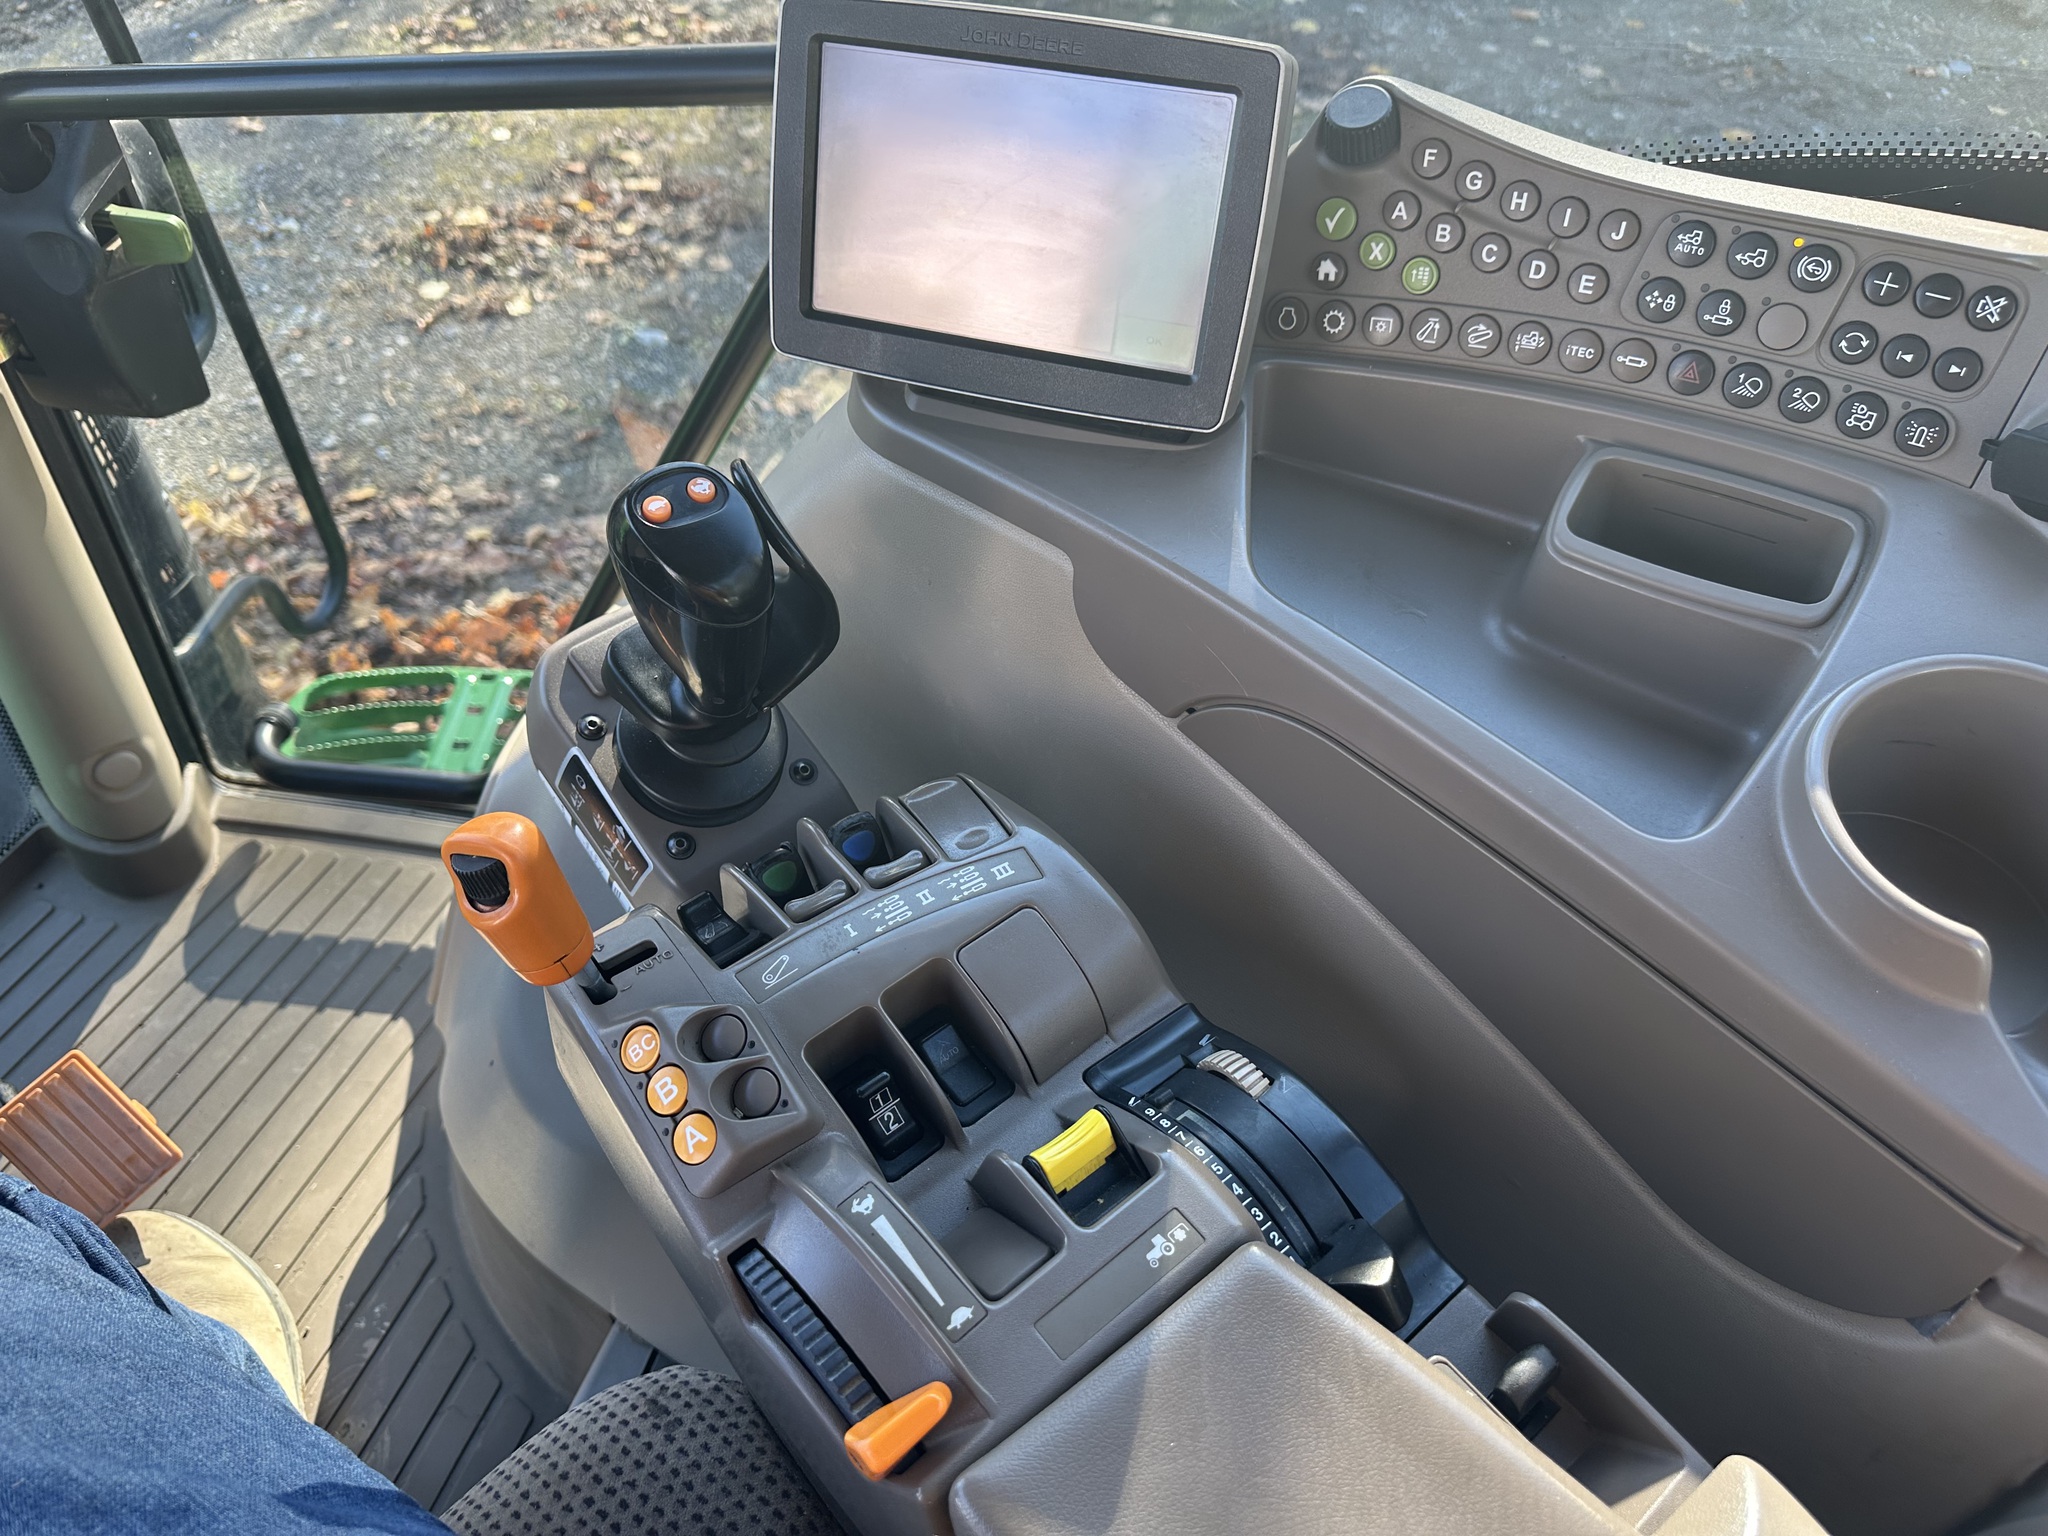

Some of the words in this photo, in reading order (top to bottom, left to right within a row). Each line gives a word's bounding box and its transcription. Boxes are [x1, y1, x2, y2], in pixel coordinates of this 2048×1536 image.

[960, 25, 1012, 48] JOHN
[1017, 32, 1084, 56] DEERE
[1423, 148, 1438, 168] F
[1465, 171, 1482, 191] G
[1391, 201, 1408, 221] A
[1509, 191, 1528, 212] H
[1562, 208, 1572, 228] I
[1435, 223, 1451, 243] B
[1610, 221, 1627, 241] J
[1481, 243, 1498, 263] C
[1674, 243, 1705, 256] AUTO
[1528, 260, 1547, 280] D
[1578, 274, 1597, 295] E
[1146, 335, 1163, 347] OK
[1565, 344, 1595, 360] iTEC
[1738, 373, 1746, 384] 1
[1792, 387, 1803, 398] 2
[990, 861, 1015, 881] III
[916, 888, 936, 906] II
[635, 950, 674, 976] AUTO
[628, 1033, 657, 1064] BC
[940, 1046, 960, 1065] AUTO
[654, 1076, 680, 1106] B
[875, 1093, 885, 1107] 1
[884, 1111, 899, 1130] 2
[1144, 1107, 1156, 1117] 9
[1159, 1118, 1172, 1128] 8
[683, 1124, 709, 1154] A
[1175, 1130, 1187, 1141] 7
[1193, 1145, 1206, 1157] 6
[1211, 1162, 1224, 1175] 5
[1231, 1182, 1244, 1195] 4
[1250, 1207, 1264, 1221] 3
[1269, 1231, 1283, 1246] 2
